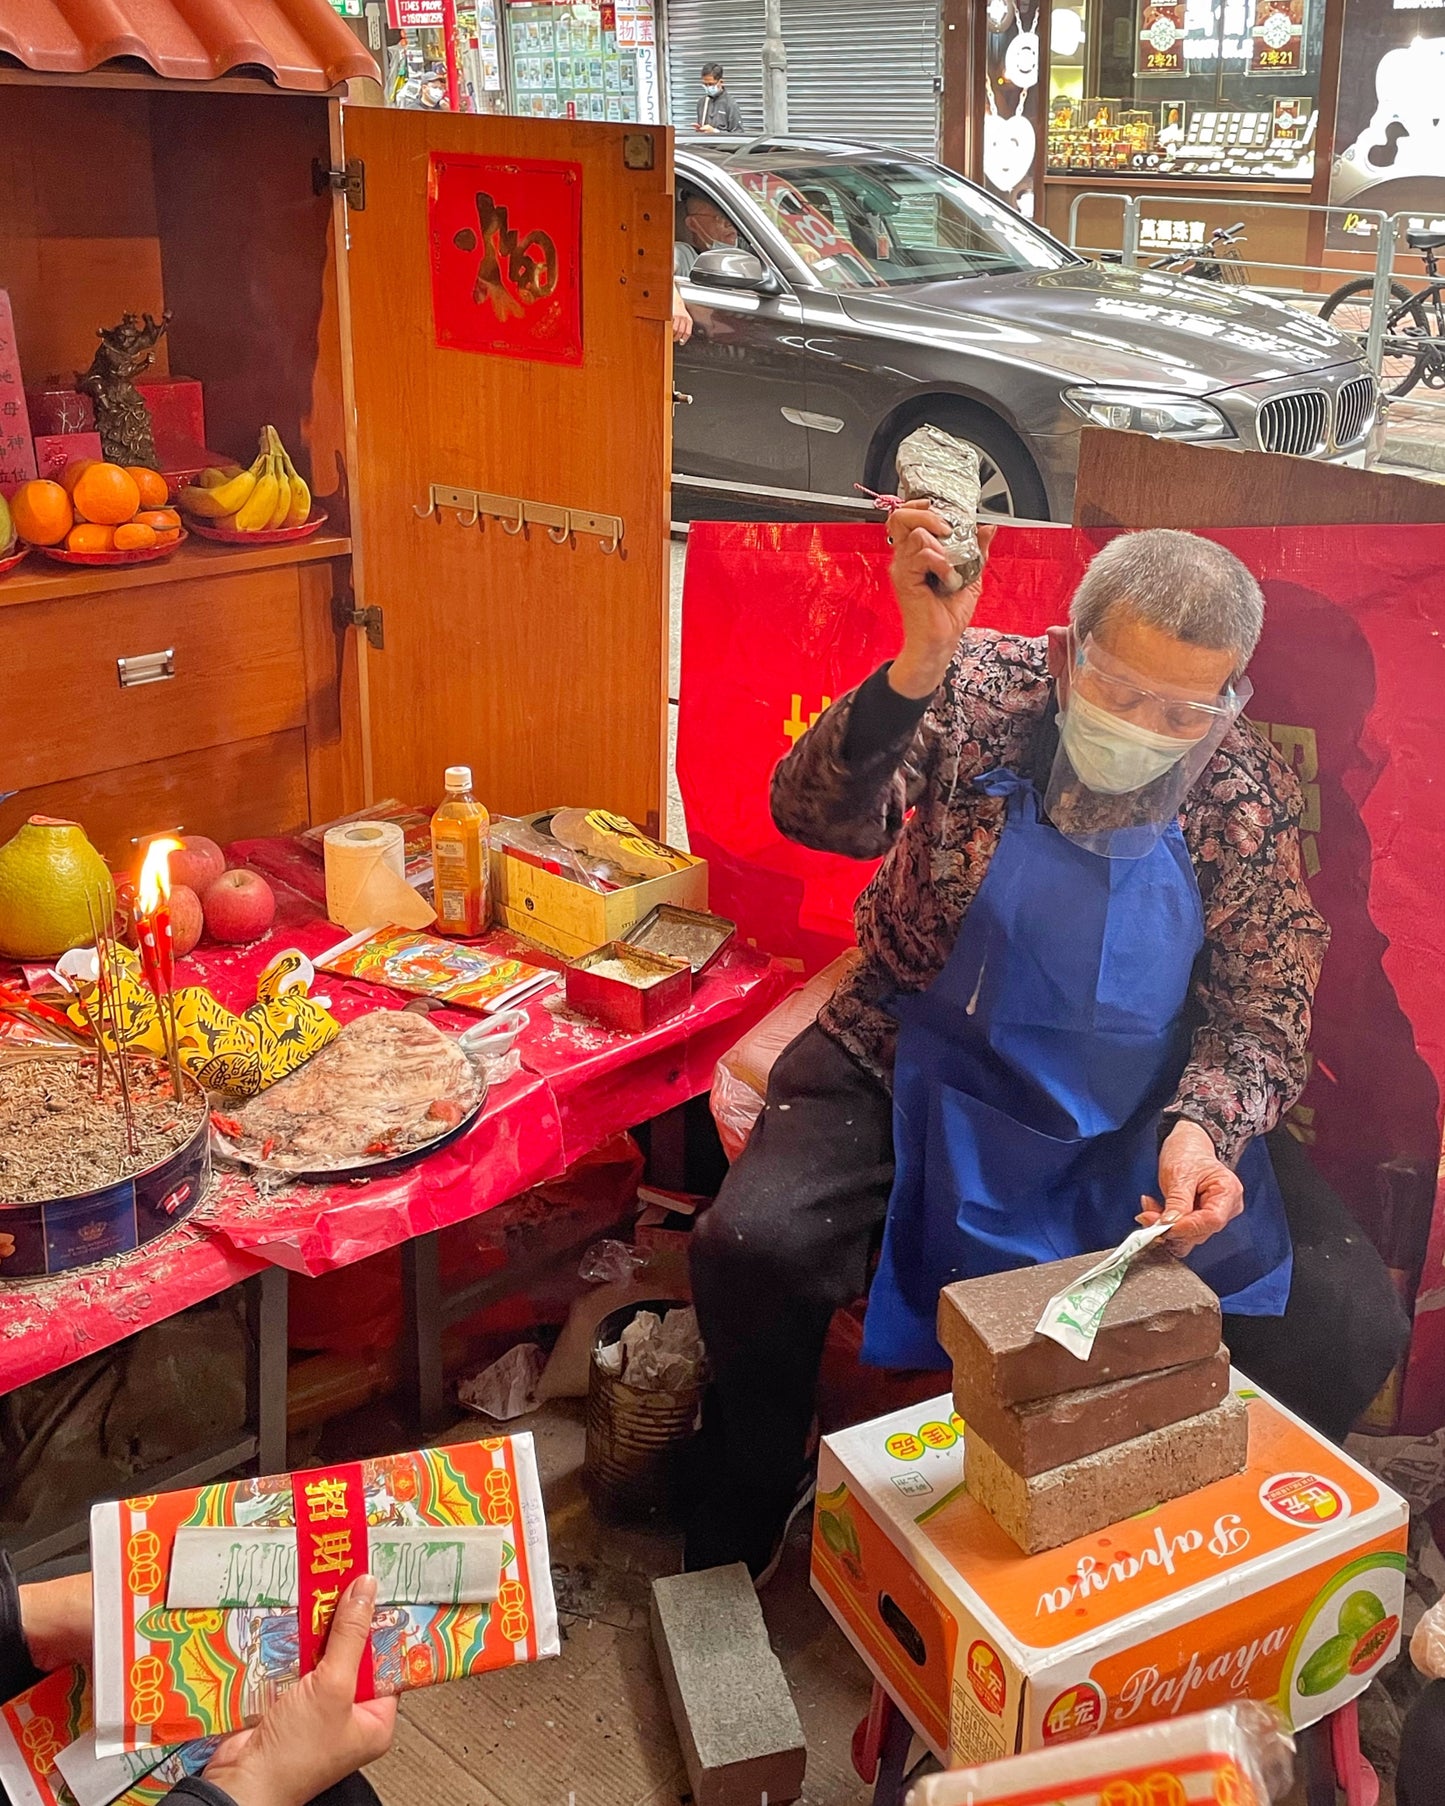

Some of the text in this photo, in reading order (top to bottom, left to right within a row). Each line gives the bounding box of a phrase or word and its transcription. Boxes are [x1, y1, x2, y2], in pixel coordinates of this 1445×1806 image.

[619, 22, 654, 41] 物業
[453, 191, 558, 322] 福
[891, 1417, 963, 1456] 佳品
[303, 1477, 354, 1664] 招財進
[1035, 1514, 1250, 1617] Papaya
[1114, 1624, 1293, 1720] Papaya
